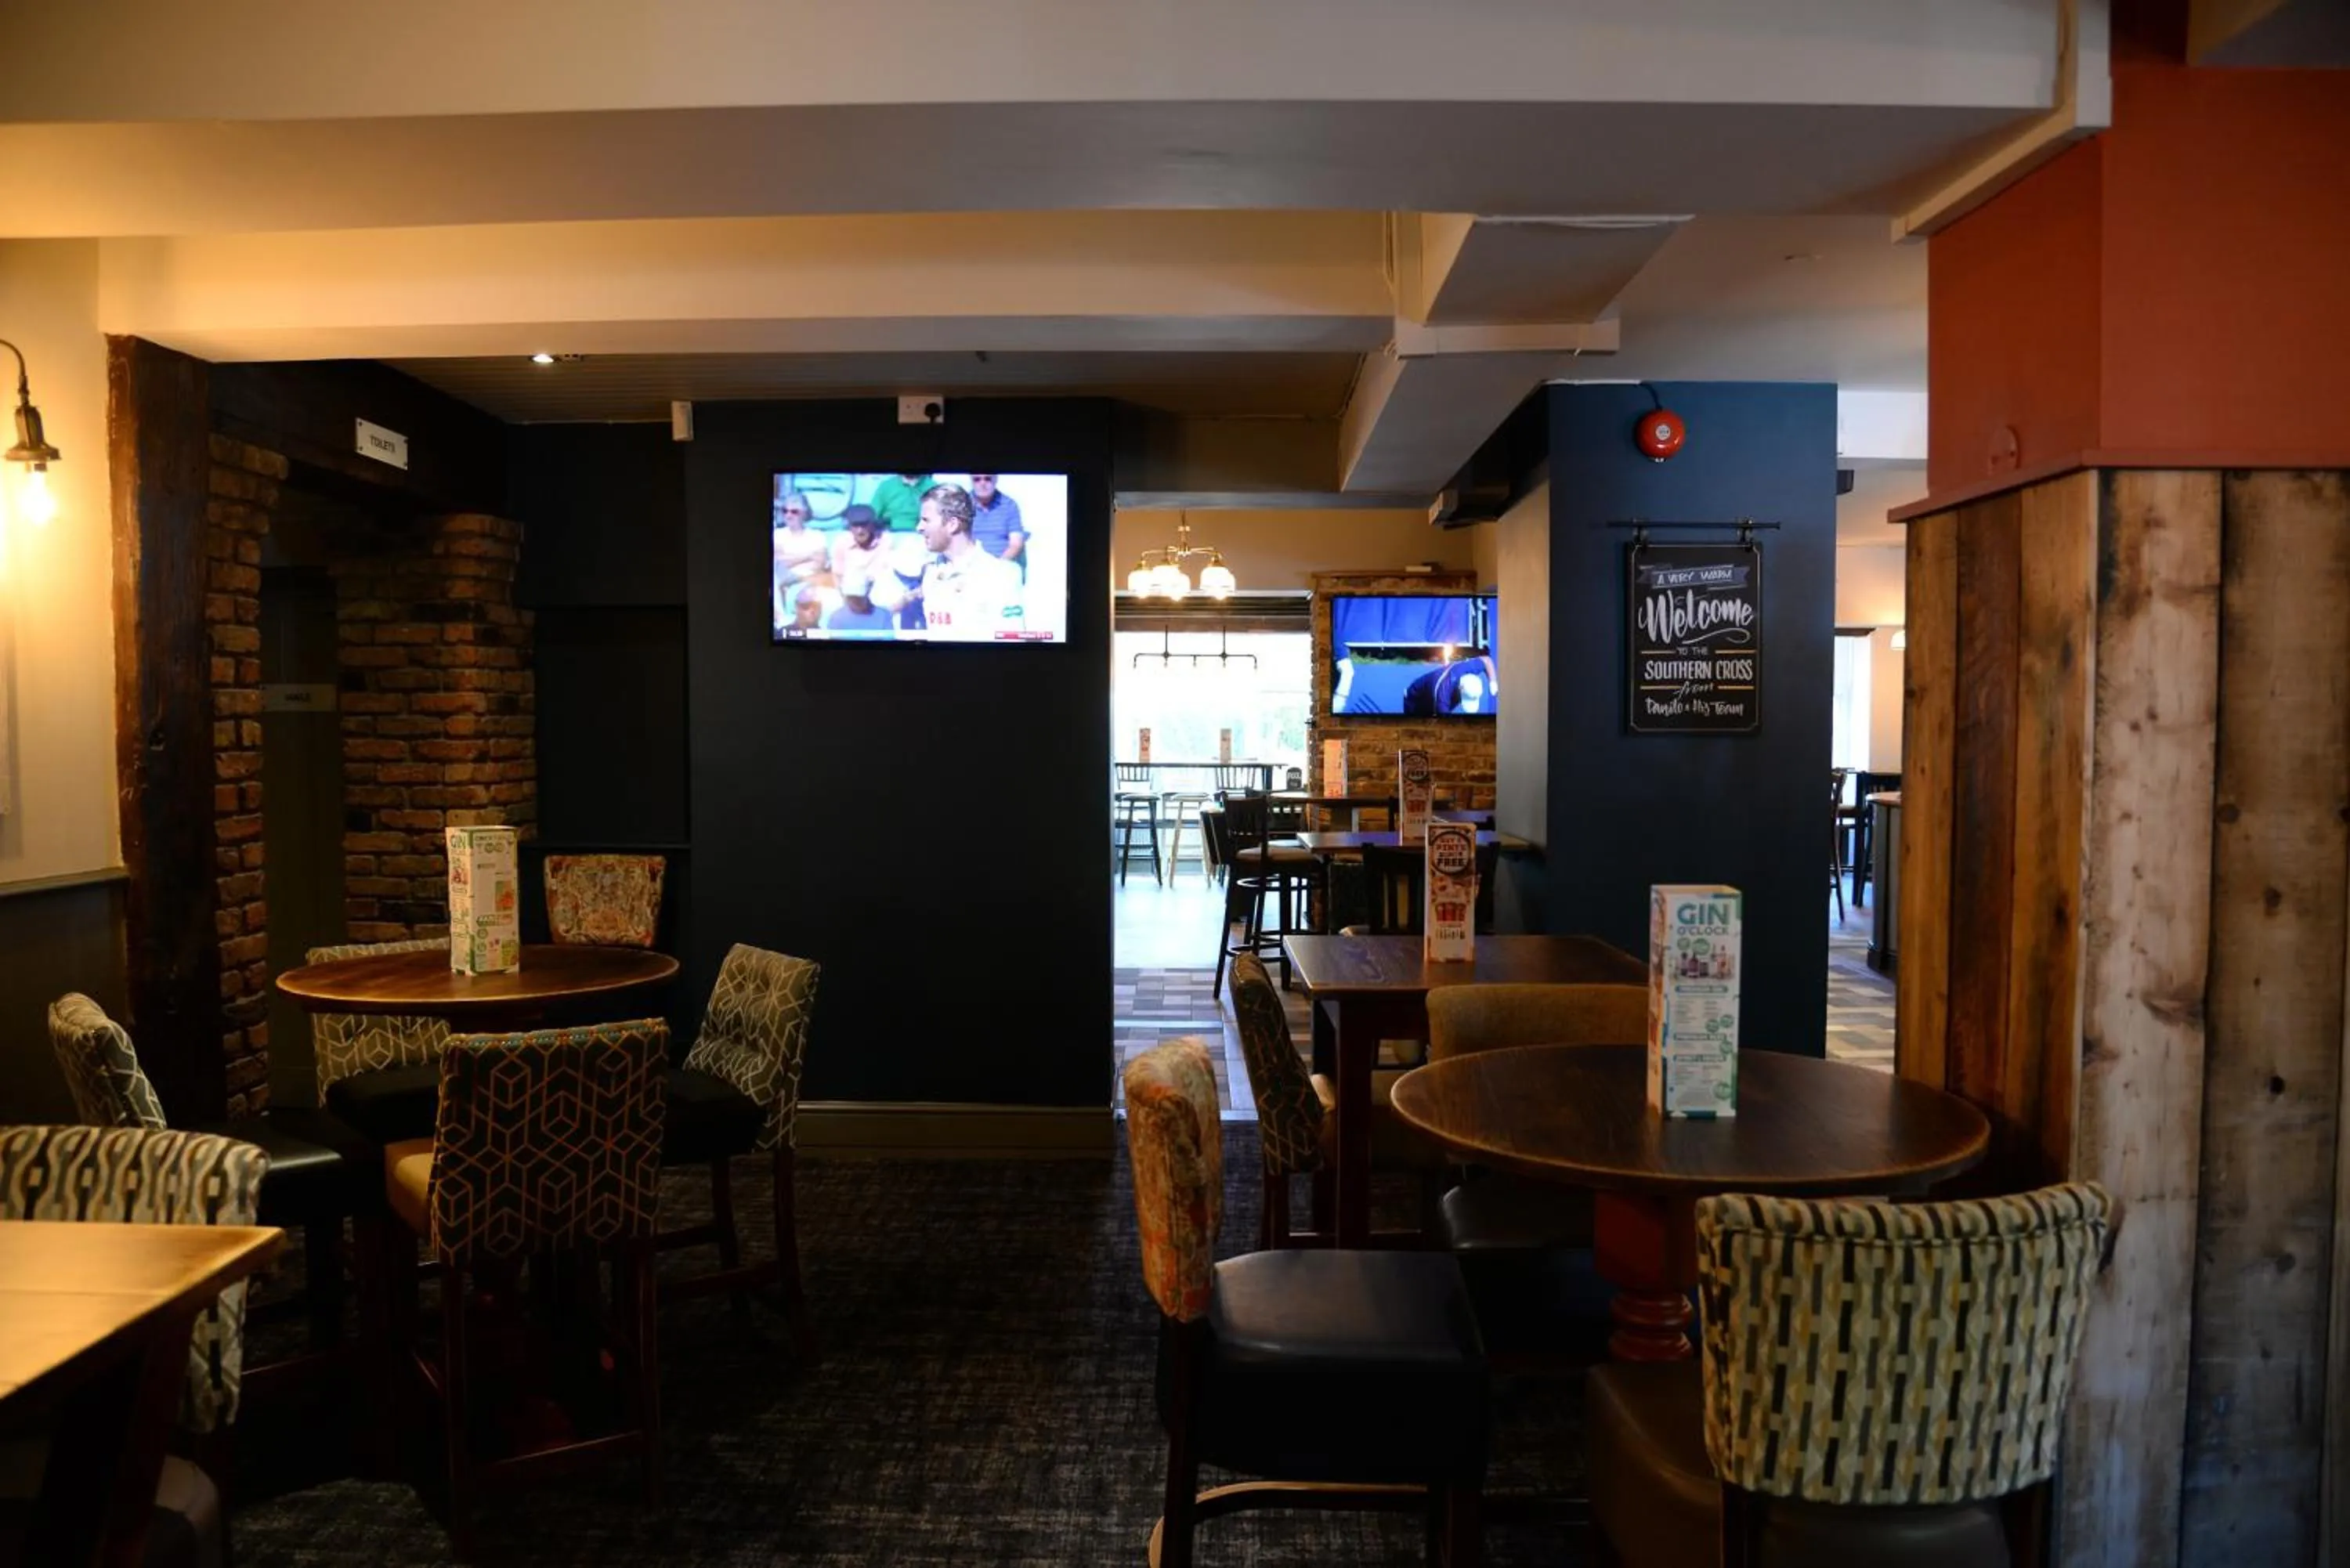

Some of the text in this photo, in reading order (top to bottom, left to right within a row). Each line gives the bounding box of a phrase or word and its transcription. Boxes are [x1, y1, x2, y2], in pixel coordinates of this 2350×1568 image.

[1668, 571, 1694, 583] VERY
[1638, 589, 1754, 644] Welcome
[1676, 647, 1708, 656] TO THE
[1644, 659, 1753, 681] SOUTHERN CROSS
[1677, 902, 1730, 925] GIN
[1677, 926, 1730, 936] O'CLOCK
